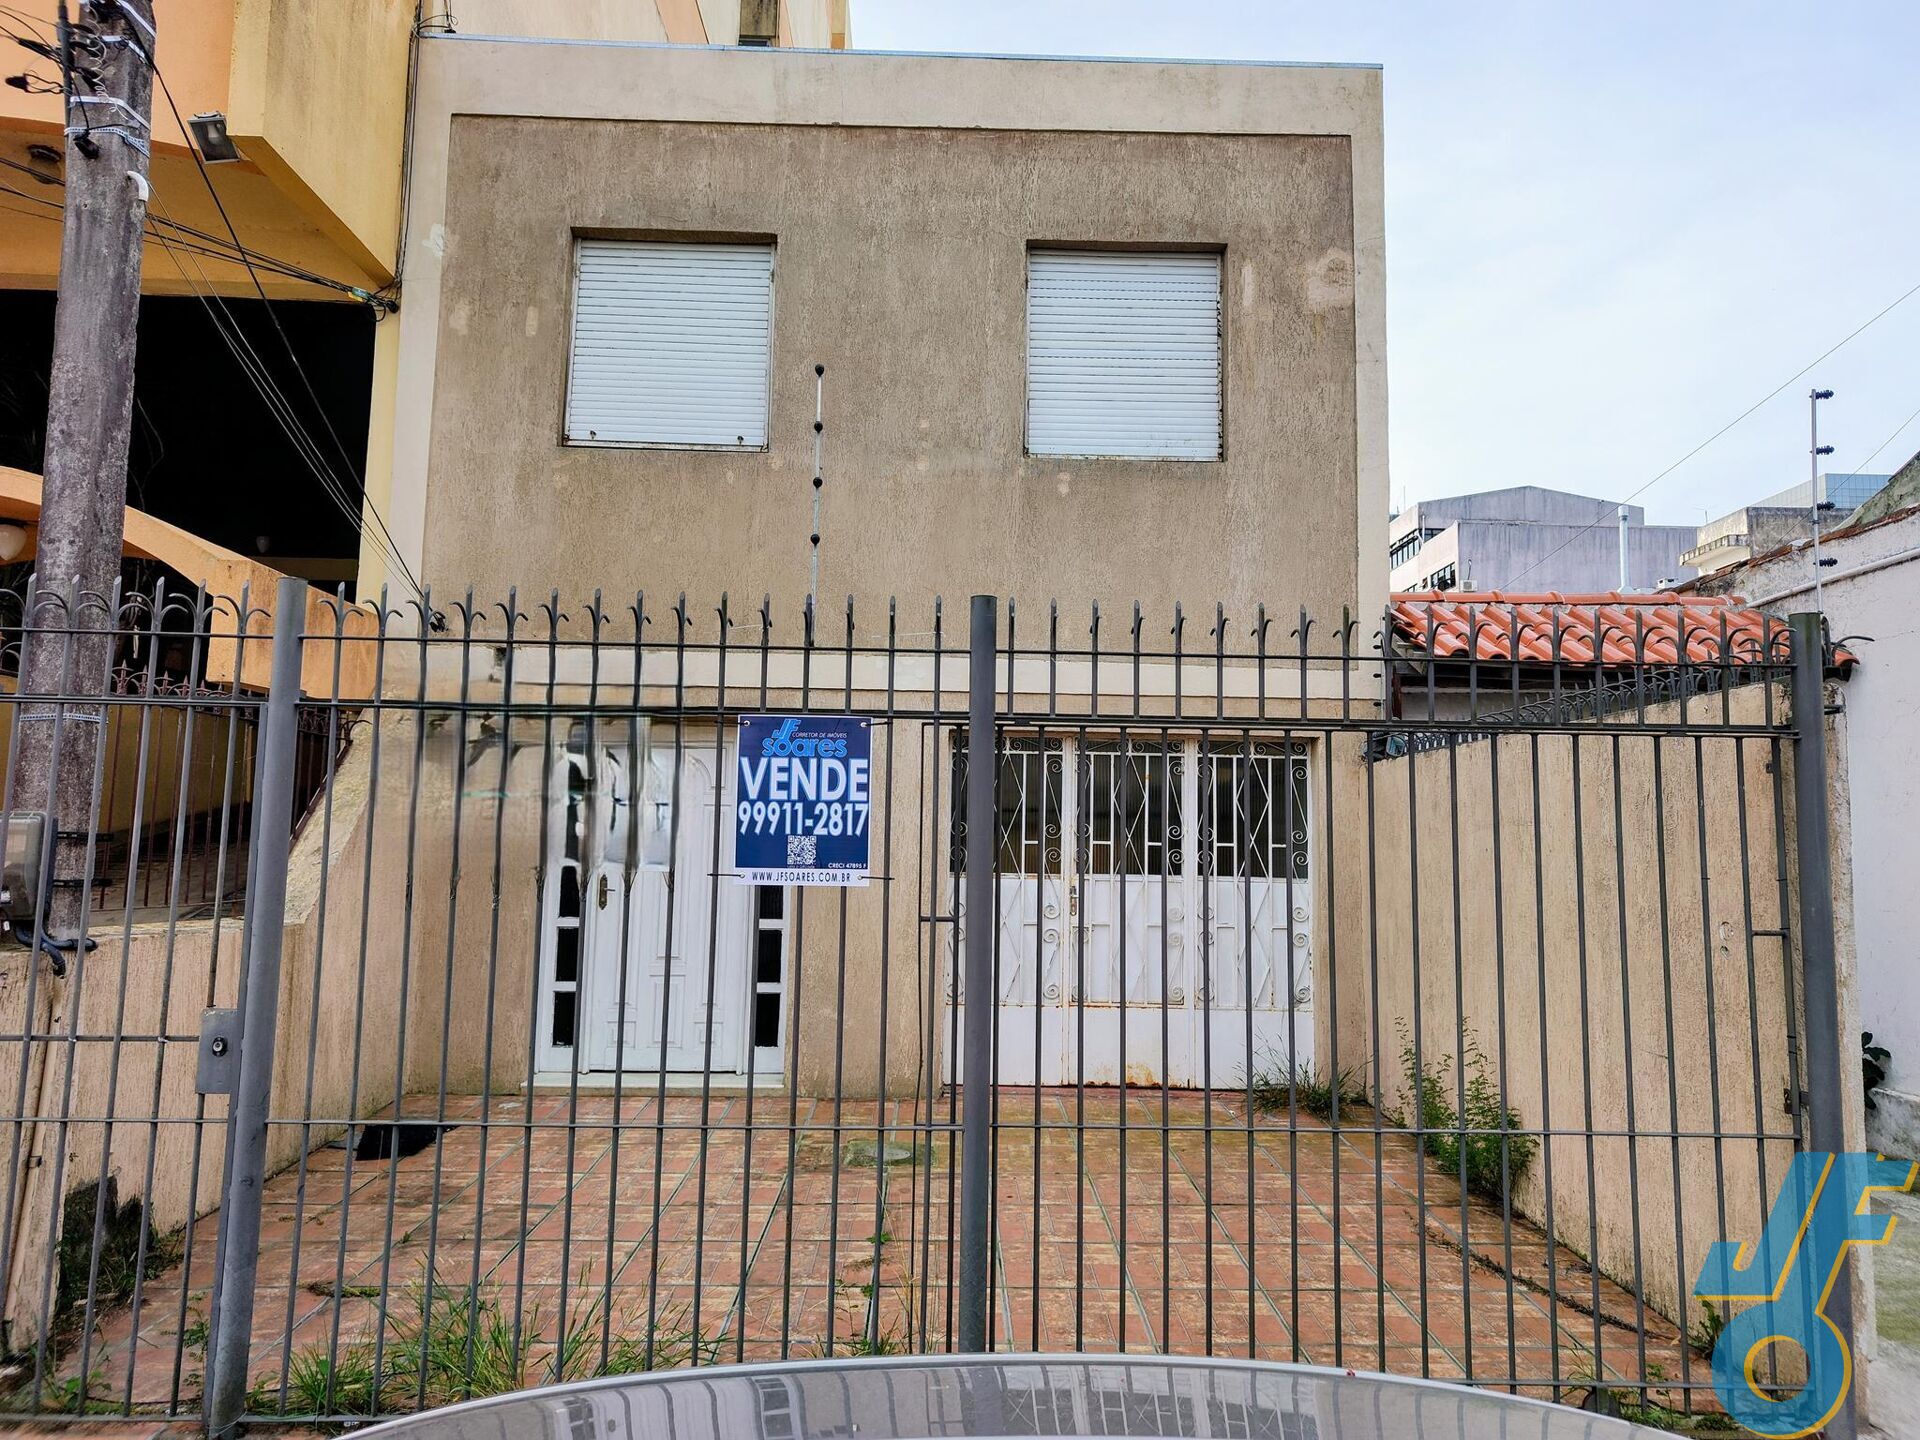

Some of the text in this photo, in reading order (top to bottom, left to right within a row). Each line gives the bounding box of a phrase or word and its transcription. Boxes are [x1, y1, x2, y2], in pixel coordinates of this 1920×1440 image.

[762, 738, 848, 757] soares
[740, 757, 868, 801] VENDE
[738, 801, 868, 837] 99911-2817
[752, 871, 850, 882] WWW.JFSOARES.COM.BR
